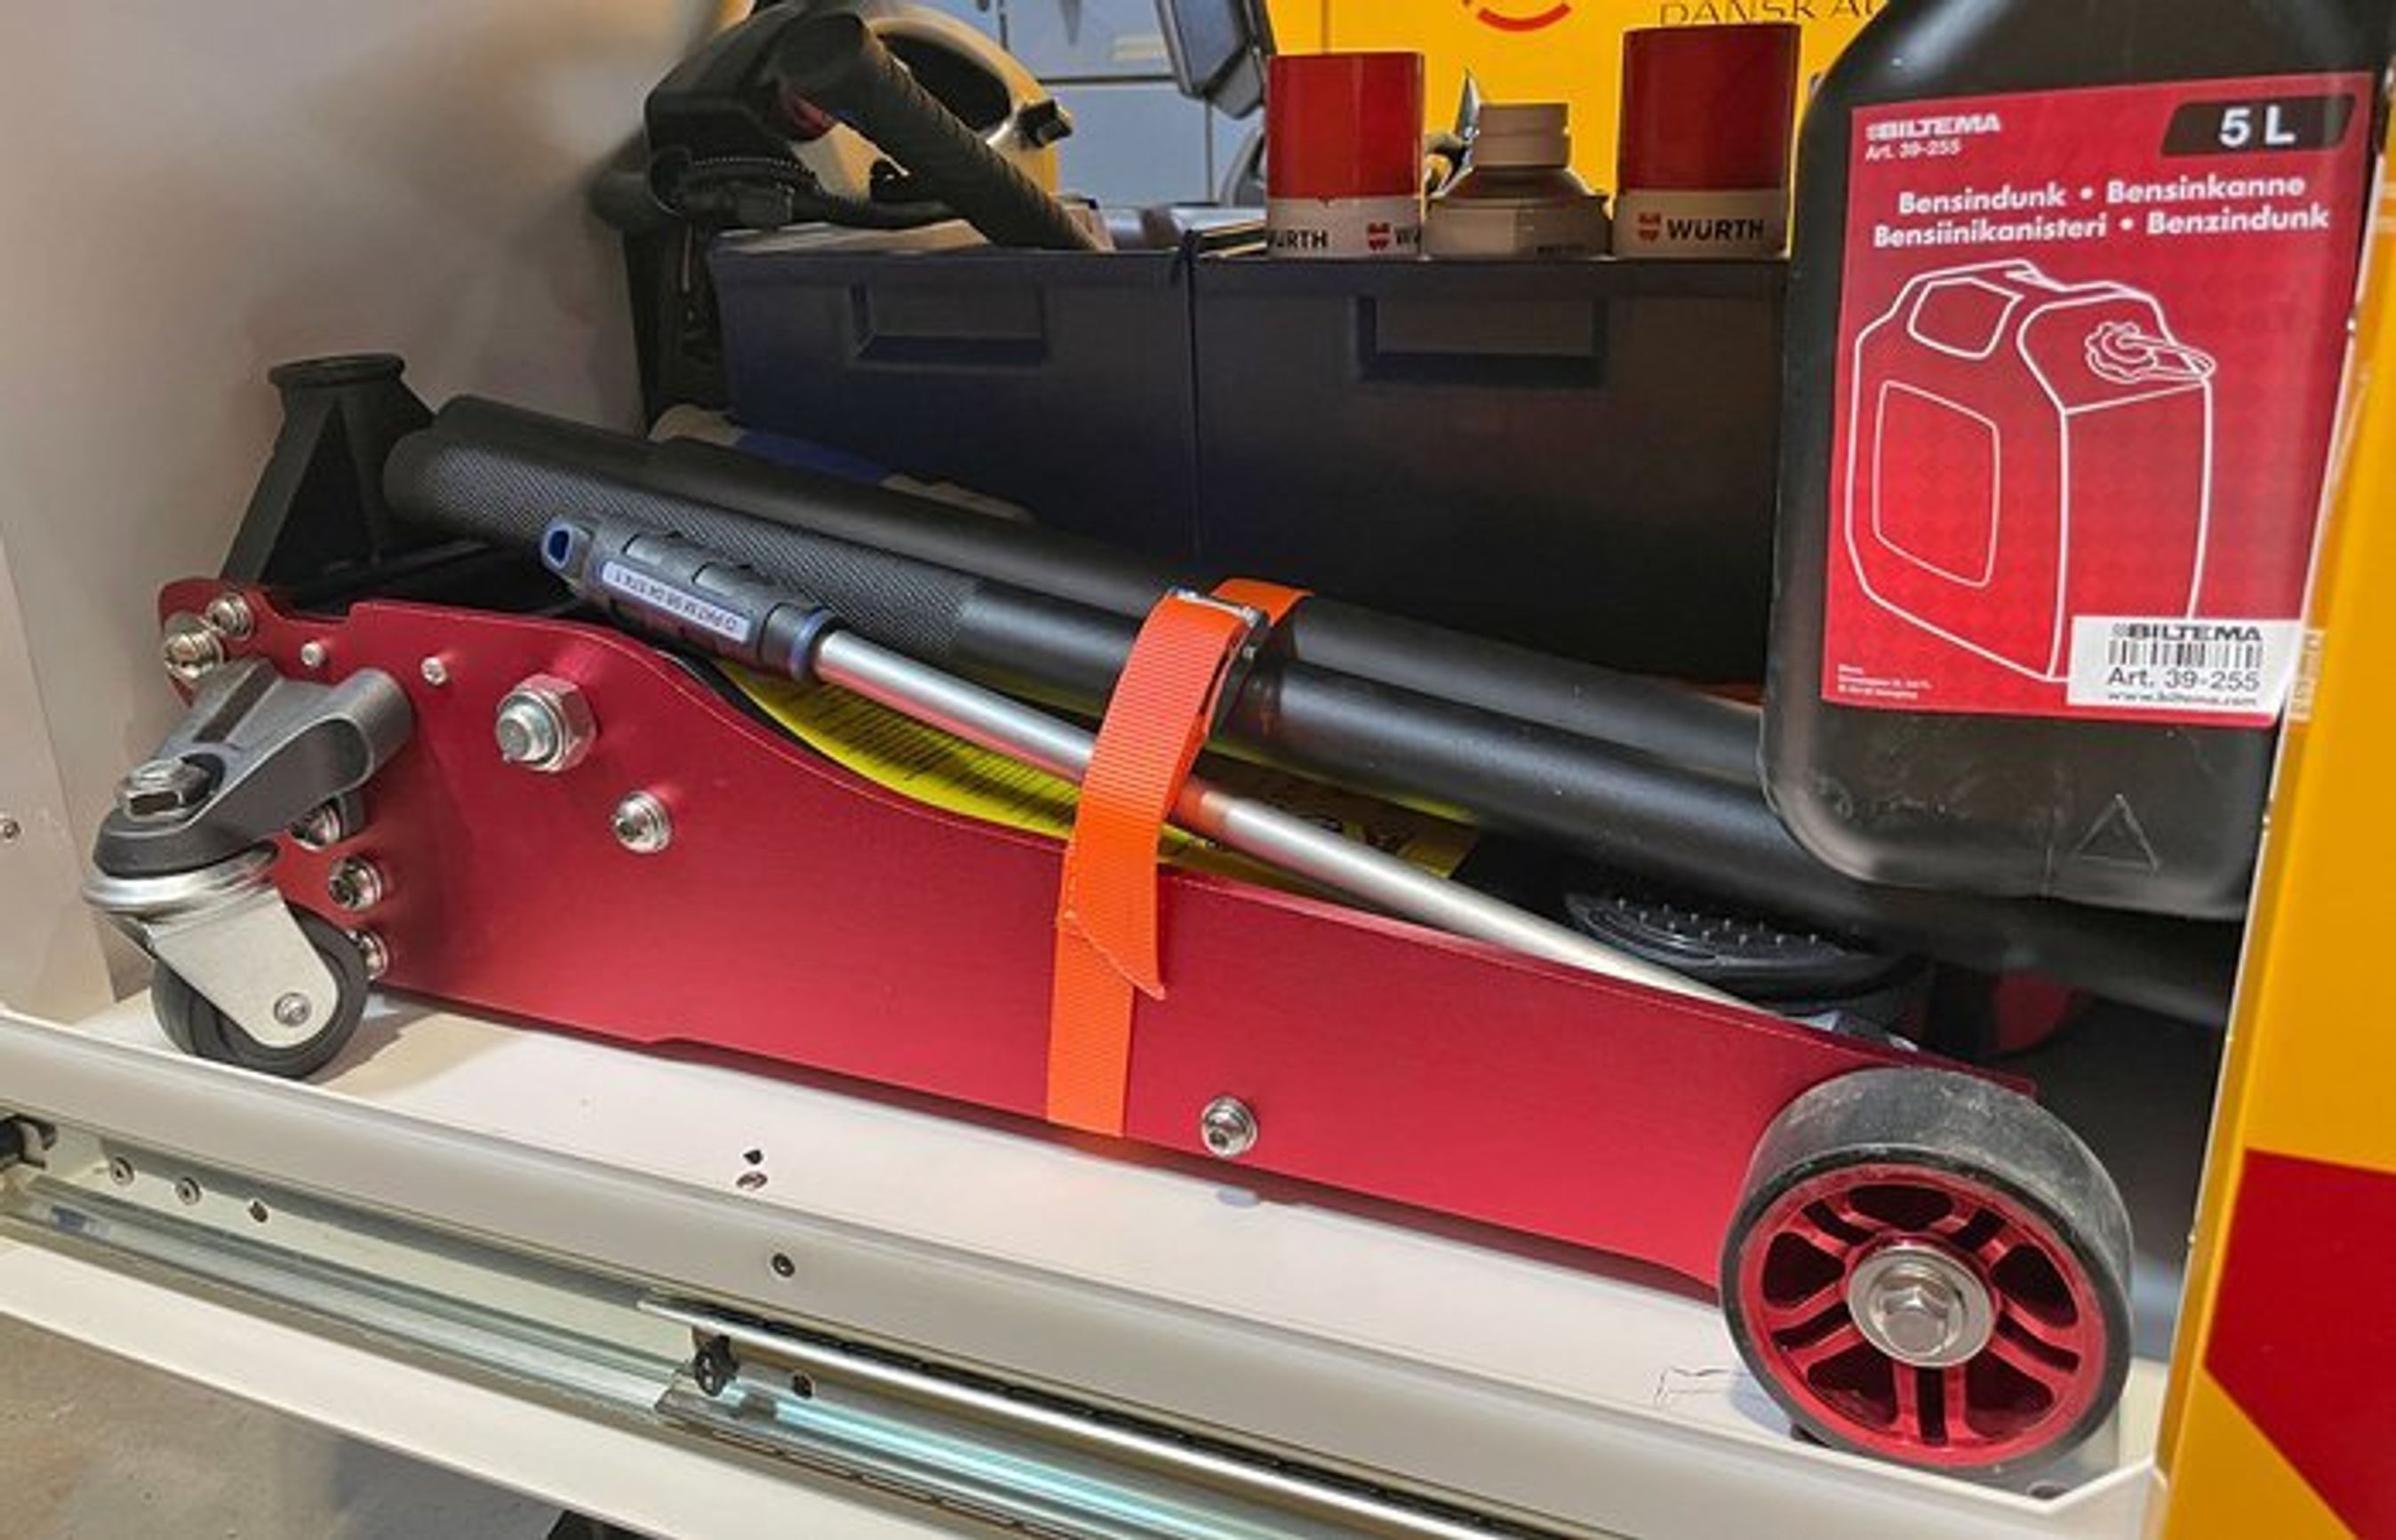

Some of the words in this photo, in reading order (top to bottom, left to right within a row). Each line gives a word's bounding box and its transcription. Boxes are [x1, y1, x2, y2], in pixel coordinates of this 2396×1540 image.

[1879, 113, 2001, 140] BILTEMA
[2219, 107, 2251, 147] 5
[2264, 105, 2296, 145] L
[1898, 182, 2066, 214] Bensindunk
[2106, 173, 2305, 203] Bensinkanne
[1873, 212, 2107, 247] Bensiinikanisteri
[2146, 202, 2329, 235] Benzindunk
[2128, 623, 2262, 641] BILTEMA
[2107, 666, 2155, 687] Art.
[2163, 668, 2260, 692] 39-255
